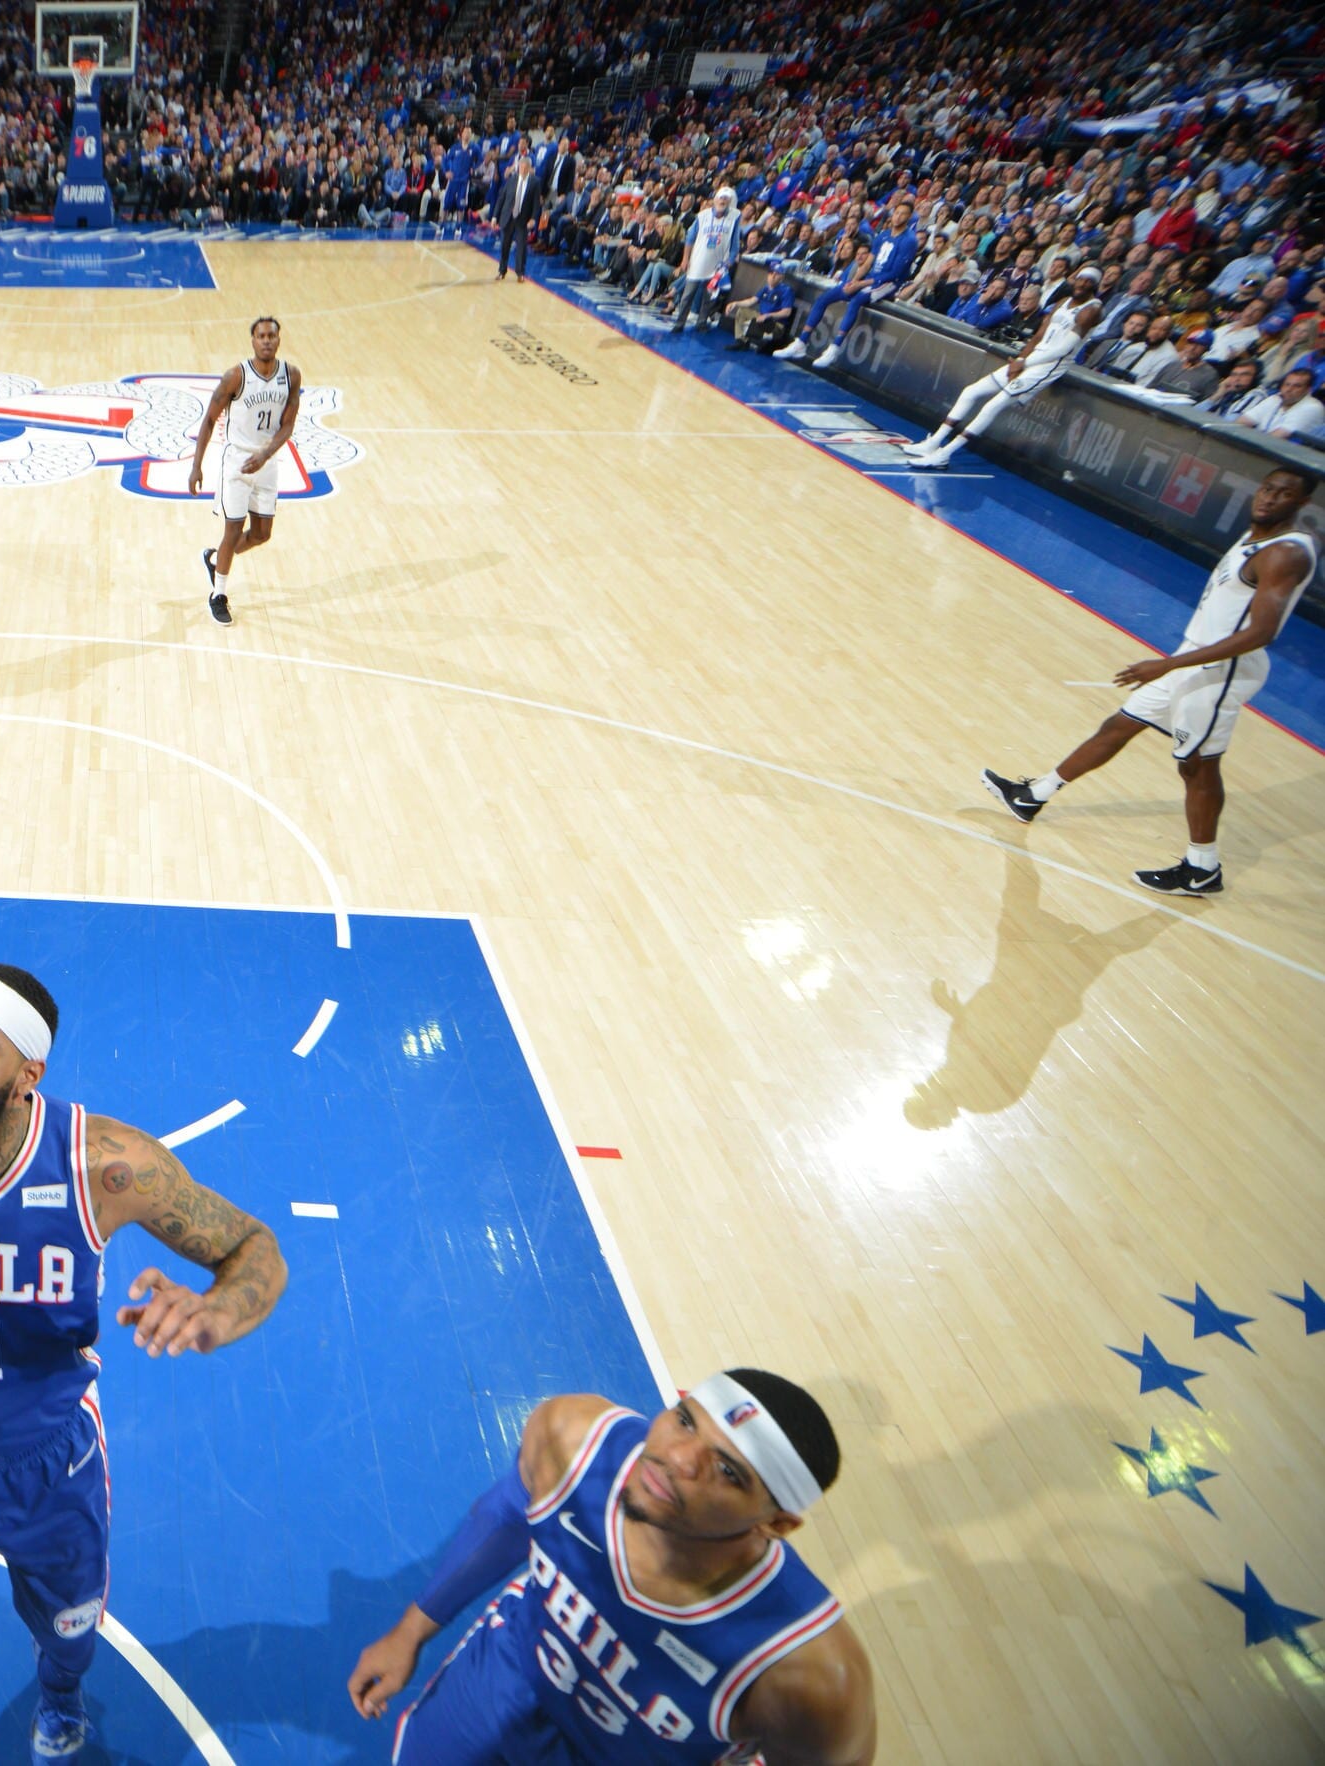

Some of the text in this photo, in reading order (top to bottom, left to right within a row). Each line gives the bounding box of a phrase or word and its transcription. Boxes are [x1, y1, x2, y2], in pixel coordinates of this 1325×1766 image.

[74, 136, 97, 159] 76
[70, 184, 106, 203] PLAYOFFS
[789, 301, 897, 374] TSOT
[257, 410, 272, 431] 21
[1012, 398, 1064, 426] ICIAL
[1007, 412, 1053, 445] WATCH
[1072, 417, 1125, 477] NBA
[27, 1191, 61, 1201] StubHub
[528, 1538, 695, 1743] PHILA
[536, 1628, 630, 1736] 33
